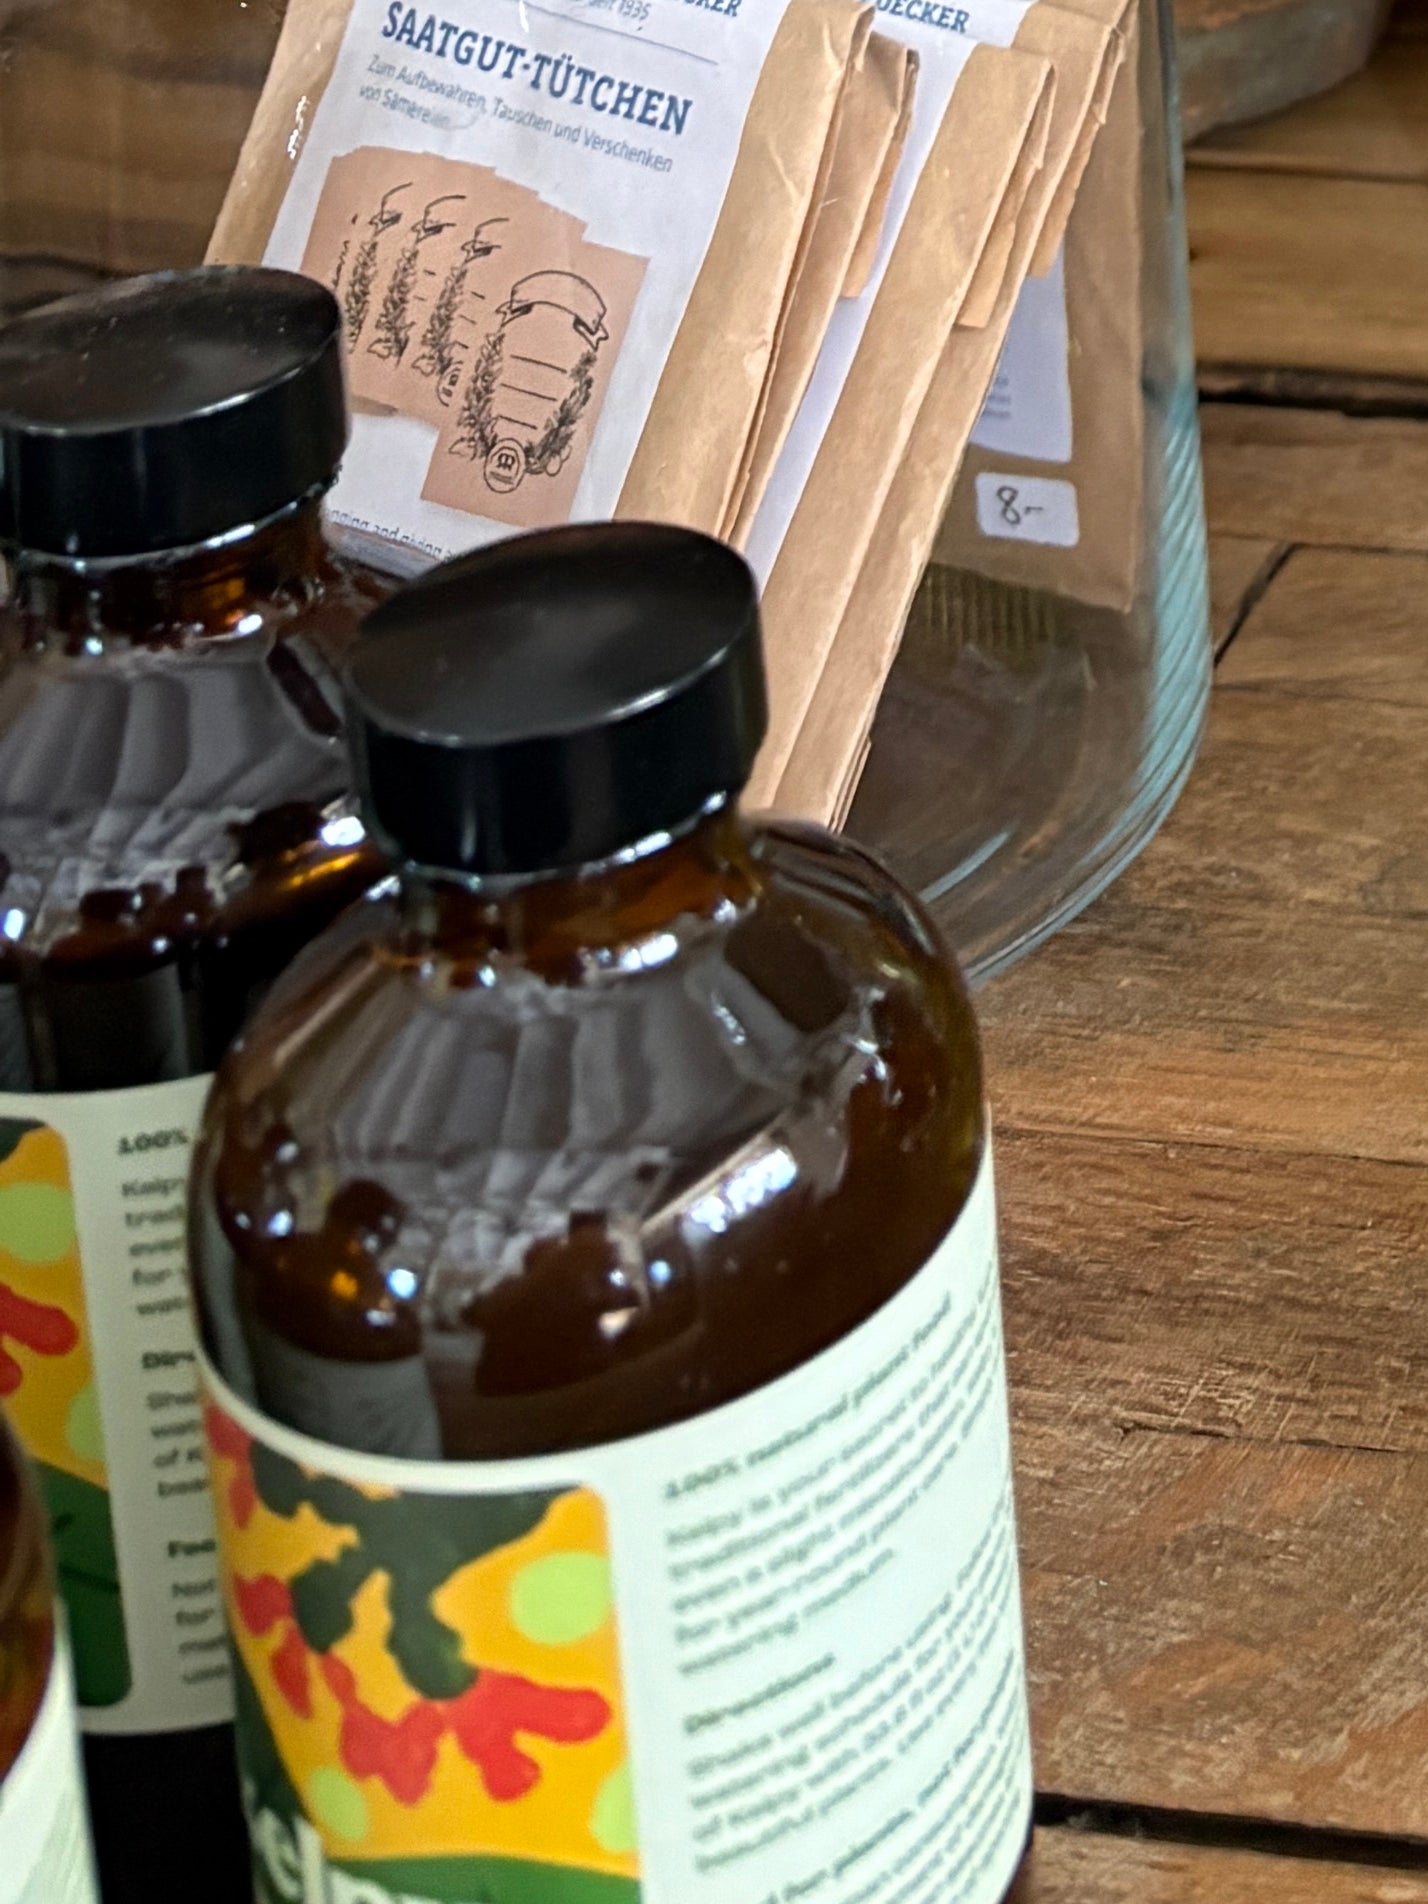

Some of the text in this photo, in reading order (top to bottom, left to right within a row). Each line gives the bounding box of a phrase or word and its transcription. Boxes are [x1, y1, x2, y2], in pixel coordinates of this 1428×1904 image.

[359, 84, 382, 101] von
[367, 54, 675, 174] Zum Aufbewahren, Tauschen und Verschenken
[381, 0, 694, 137] SAATGUT-TÜTCHEN
